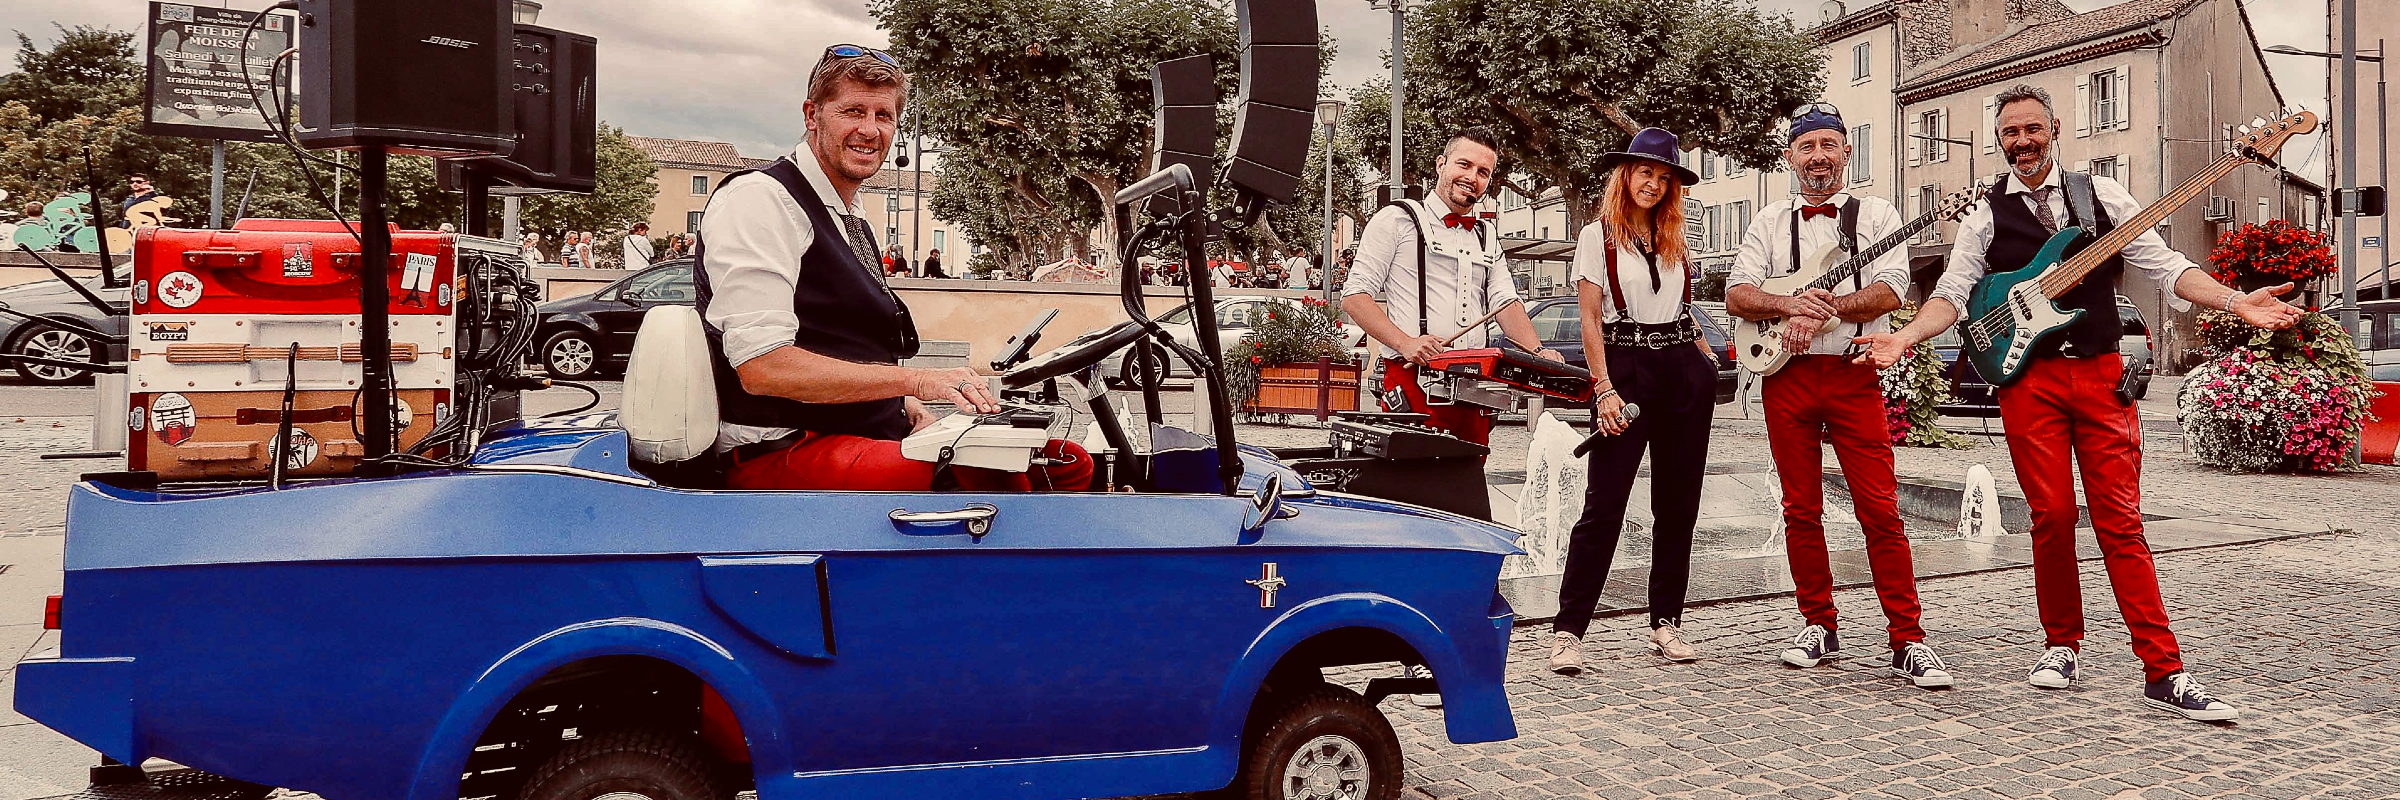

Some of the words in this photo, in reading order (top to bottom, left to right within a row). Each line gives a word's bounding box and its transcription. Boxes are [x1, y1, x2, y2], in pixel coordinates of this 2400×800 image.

[196, 15, 262, 27] Bourg-Saint-Andol
[184, 24, 217, 36] FETE
[221, 28, 241, 38] DE
[189, 36, 256, 51] MOISSON
[421, 36, 478, 49] BOSE
[164, 49, 214, 61] Samedi
[219, 54, 235, 63] 17
[239, 55, 275, 67] uillet
[408, 254, 435, 267] PARIS
[151, 332, 187, 340] EGYPT
[1464, 366, 1479, 375] Roland
[1528, 380, 1544, 389] Roland
[154, 399, 187, 409] JAPAN
